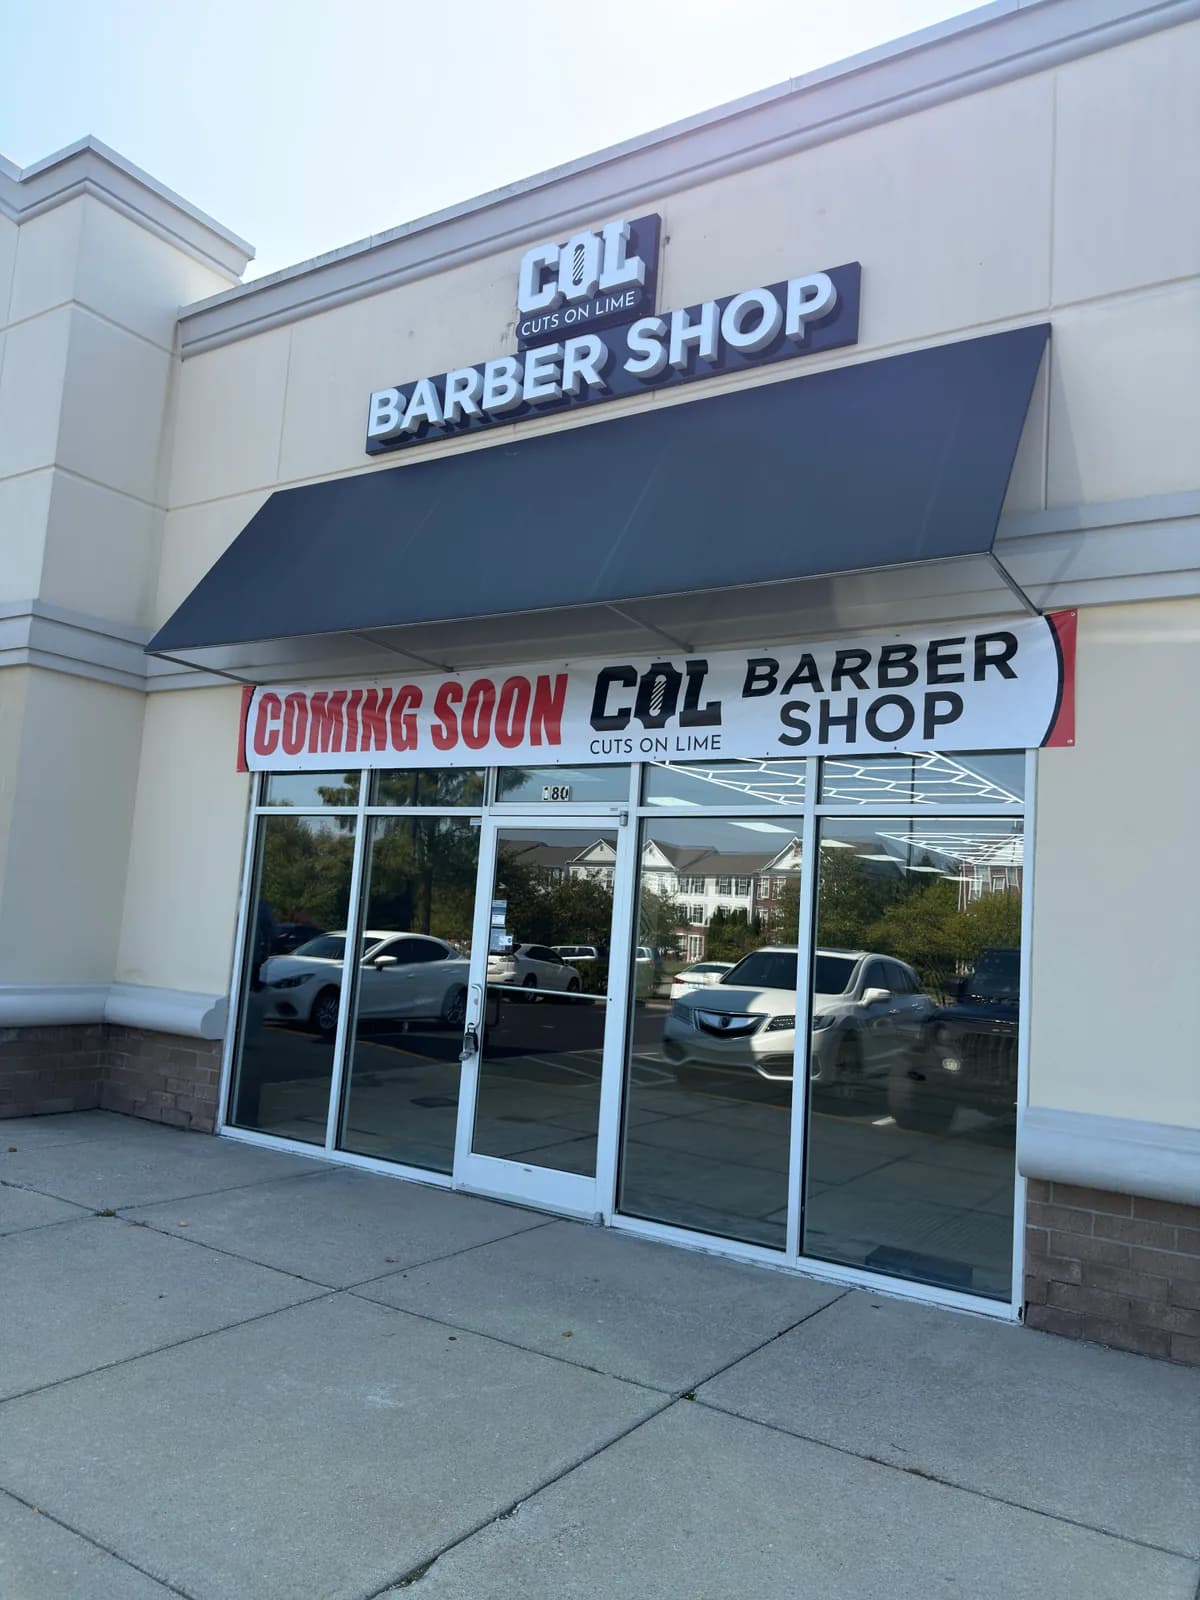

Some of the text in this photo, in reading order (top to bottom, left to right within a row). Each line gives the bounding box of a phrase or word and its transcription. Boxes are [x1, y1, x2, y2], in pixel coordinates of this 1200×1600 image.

[517, 219, 646, 313] COL
[521, 291, 635, 337] CUTS ON LIME
[368, 272, 838, 439] BARBER SHOP
[590, 659, 722, 731] COL
[742, 631, 1018, 698] BARBER
[253, 673, 569, 756] COMING SOON
[590, 735, 722, 755] CUTS ON LIME
[778, 691, 964, 746] SHOP
